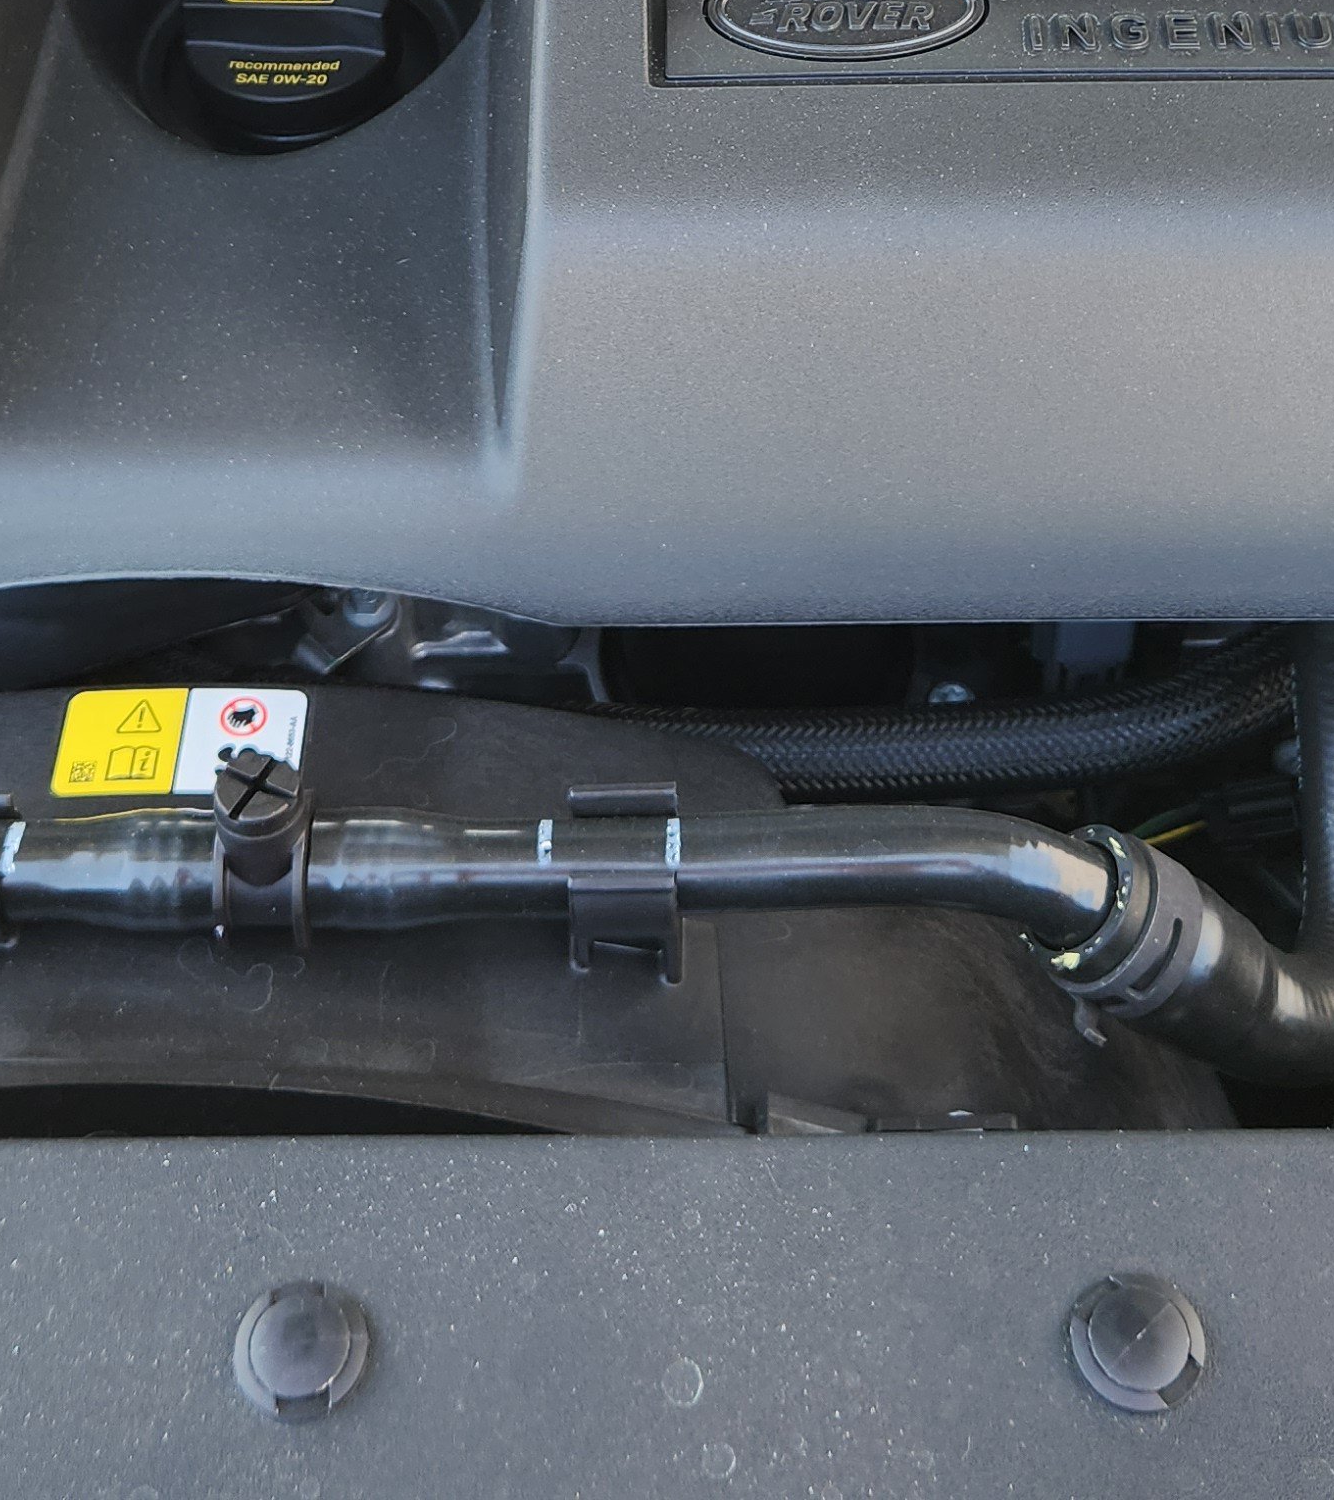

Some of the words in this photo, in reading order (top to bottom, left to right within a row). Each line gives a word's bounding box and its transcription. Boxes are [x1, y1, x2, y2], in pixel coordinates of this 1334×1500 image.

[779, 1, 935, 32] ROVER
[229, 59, 340, 71] recommended
[236, 74, 269, 85] SAE
[273, 73, 328, 85] 0W-20
